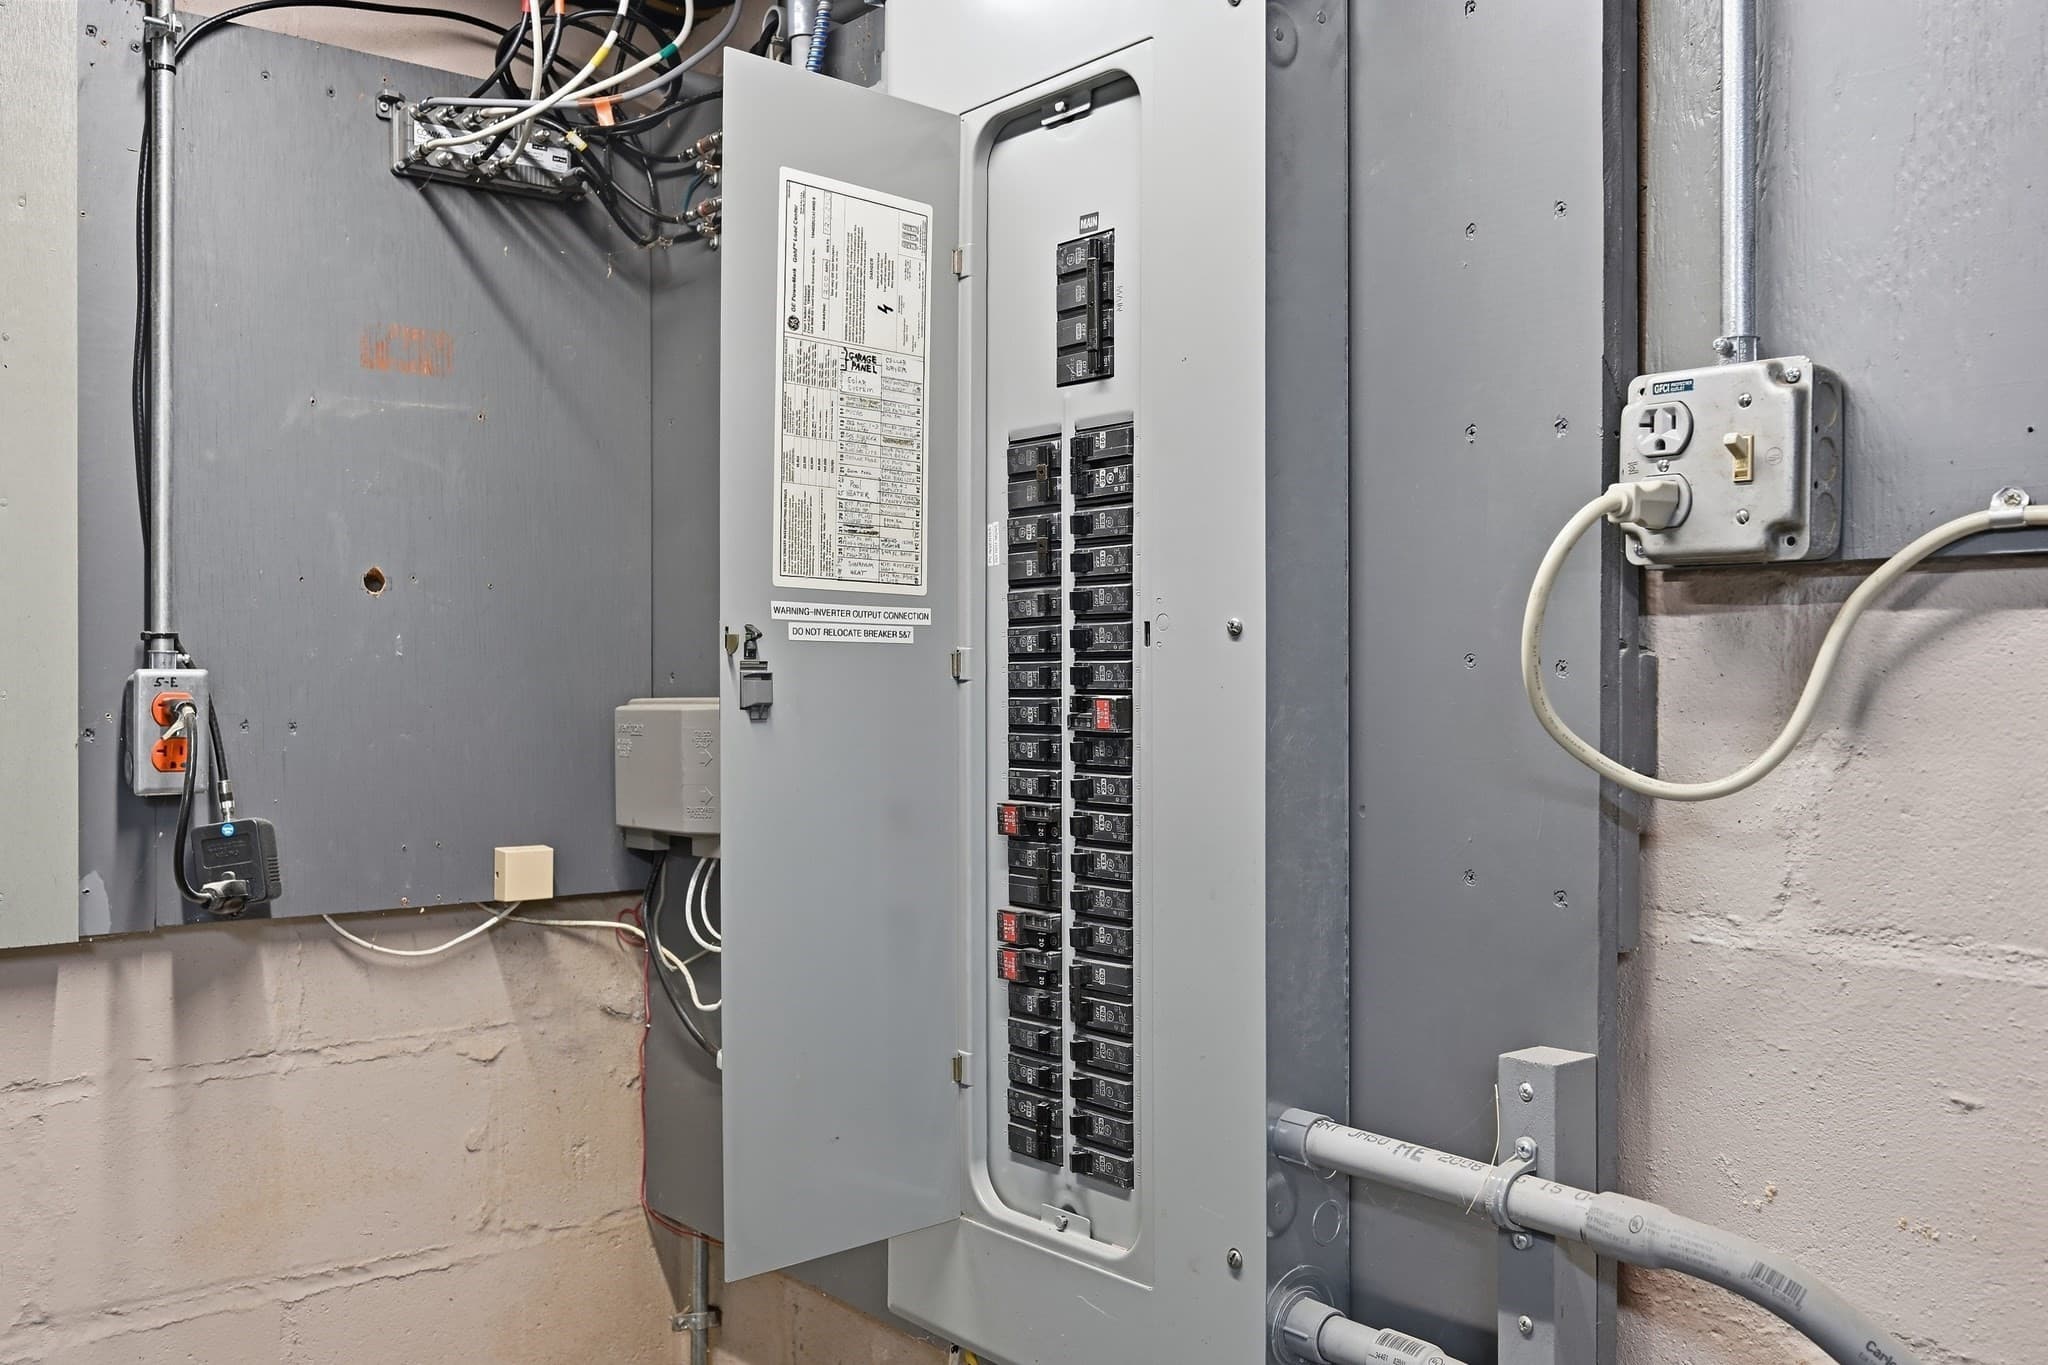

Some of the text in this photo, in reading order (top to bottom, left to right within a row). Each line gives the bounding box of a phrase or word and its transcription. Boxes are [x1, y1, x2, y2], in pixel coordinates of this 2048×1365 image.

[1080, 216, 1098, 230] MAIN
[848, 352, 877, 364] GARAGE
[851, 362, 877, 374] PANEL
[1654, 384, 1669, 393] GFCI
[773, 606, 929, 621] WARNING-INVERTER OUTPUT CONNECTION
[792, 627, 803, 636] DO
[805, 628, 821, 636] NOT
[823, 628, 862, 637] RELOCATE
[864, 630, 898, 638] BREAKER
[1038, 828, 1044, 837] 20
[1039, 938, 1045, 947] 20
[1039, 976, 1045, 985] 20
